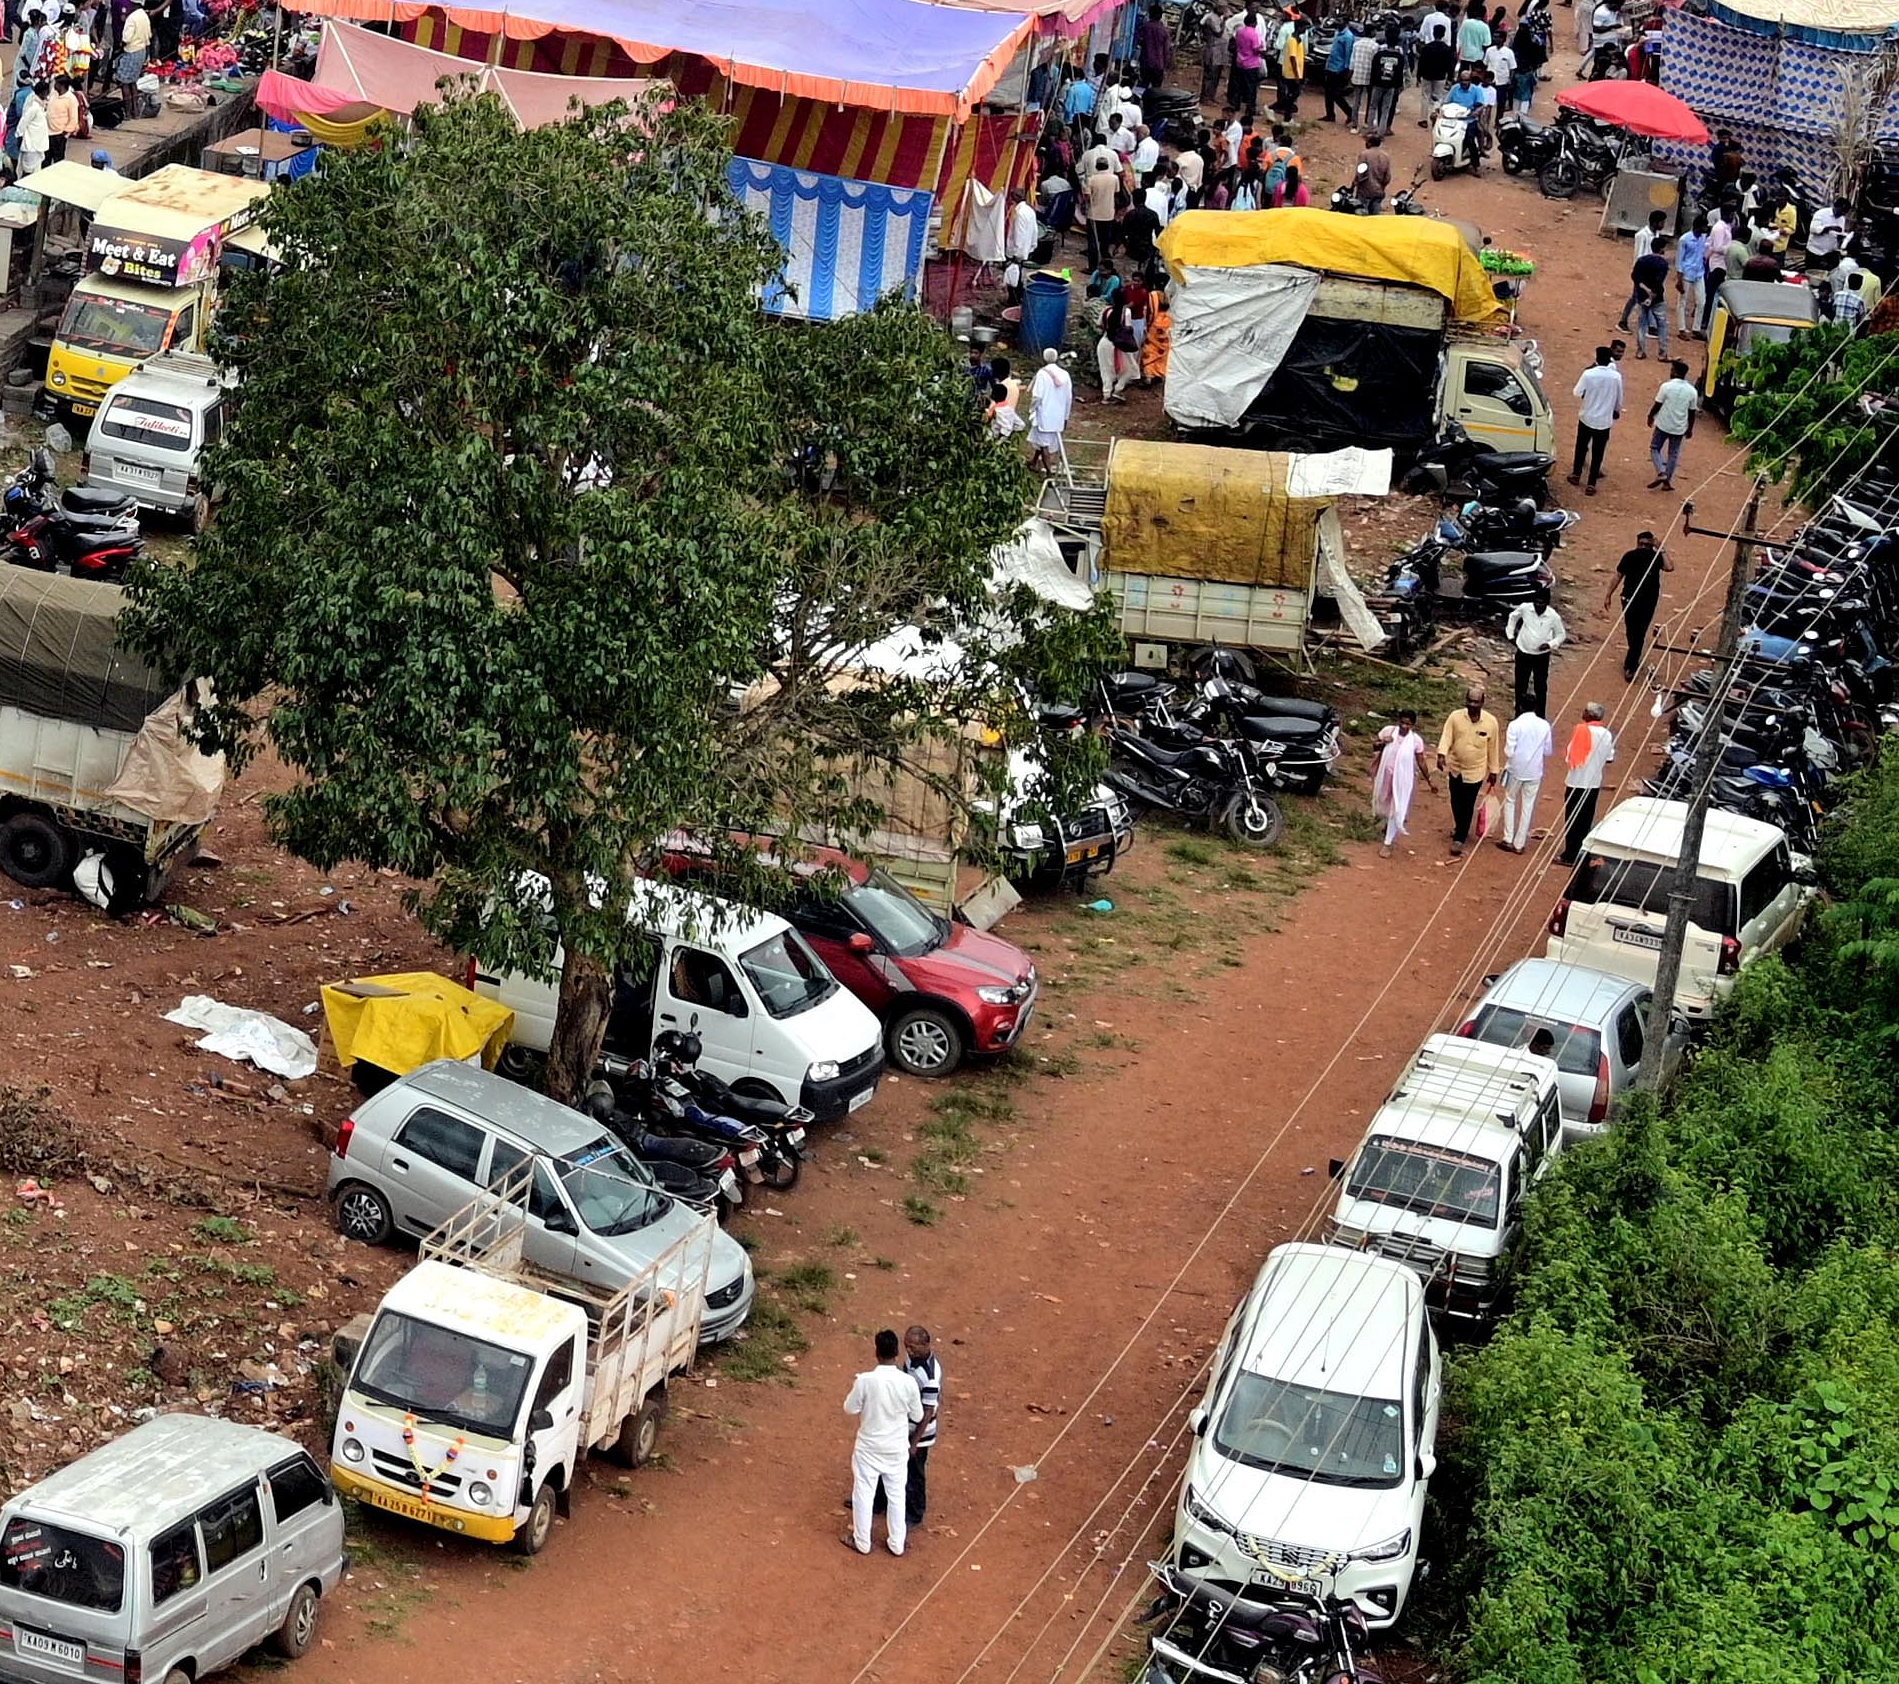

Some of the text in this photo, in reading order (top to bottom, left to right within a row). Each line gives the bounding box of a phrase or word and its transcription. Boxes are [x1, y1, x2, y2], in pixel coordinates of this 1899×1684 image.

[92, 237, 177, 268] Meet & Eat
[123, 261, 161, 279] Bites
[409, 1506, 432, 1521] 6271
[27, 1634, 80, 1660] KA09 M 6010
